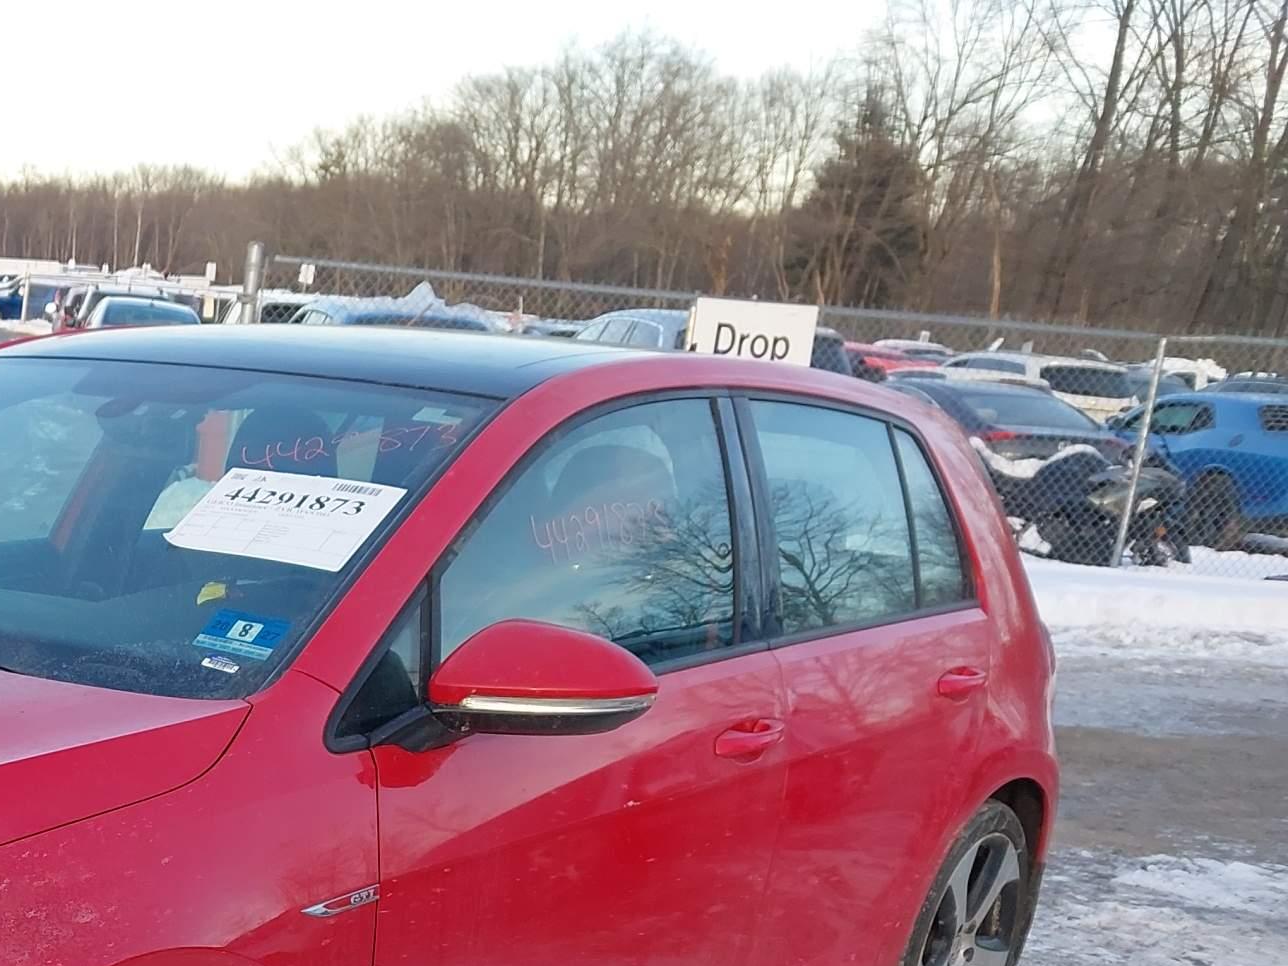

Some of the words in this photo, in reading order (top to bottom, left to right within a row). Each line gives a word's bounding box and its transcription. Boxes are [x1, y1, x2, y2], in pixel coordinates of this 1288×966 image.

[713, 322, 790, 361] Drop
[241, 423, 458, 469] 4429873
[223, 486, 367, 517] 44291873
[238, 623, 253, 637] 8
[350, 888, 375, 905] GTI
